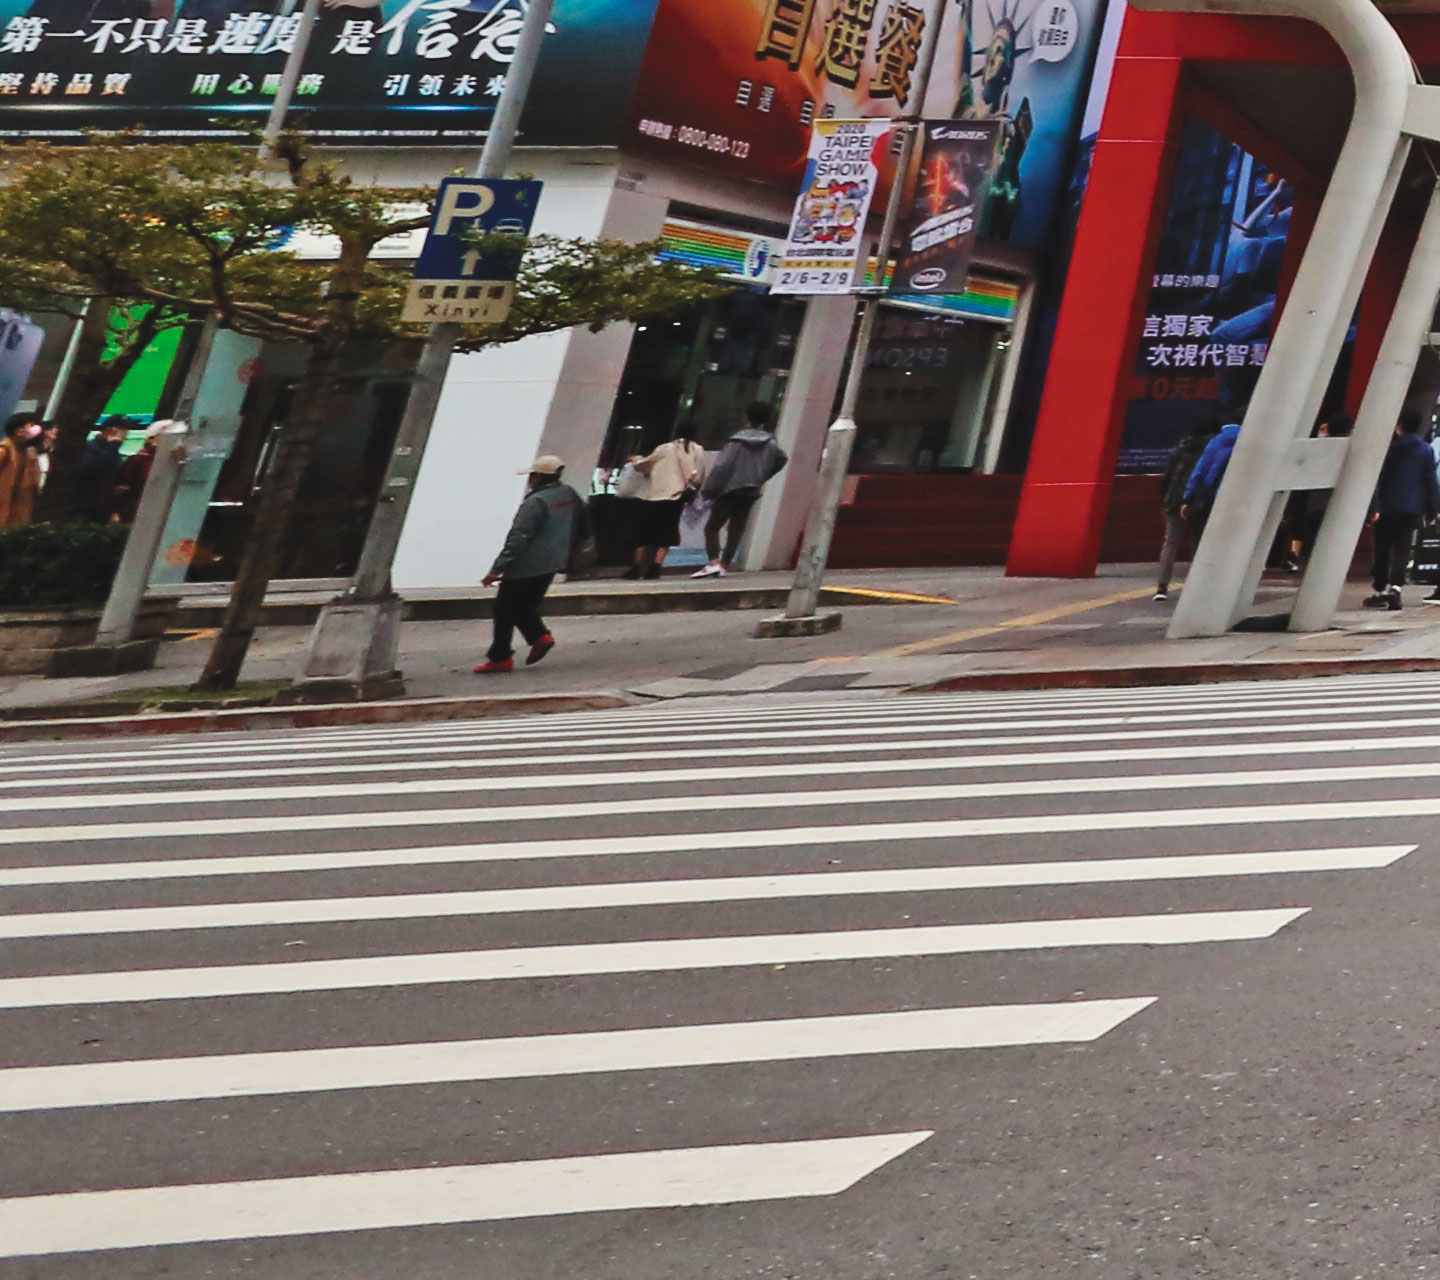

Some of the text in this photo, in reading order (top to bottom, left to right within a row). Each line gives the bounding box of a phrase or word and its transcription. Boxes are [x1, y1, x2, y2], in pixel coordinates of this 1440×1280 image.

[825, 135, 874, 149] TAIPEI
[818, 149, 871, 163] GAME
[816, 163, 869, 177] SHOW
[433, 183, 495, 236] P
[781, 271, 849, 285] 2/6-2/9
[423, 303, 490, 317] Xinyi
